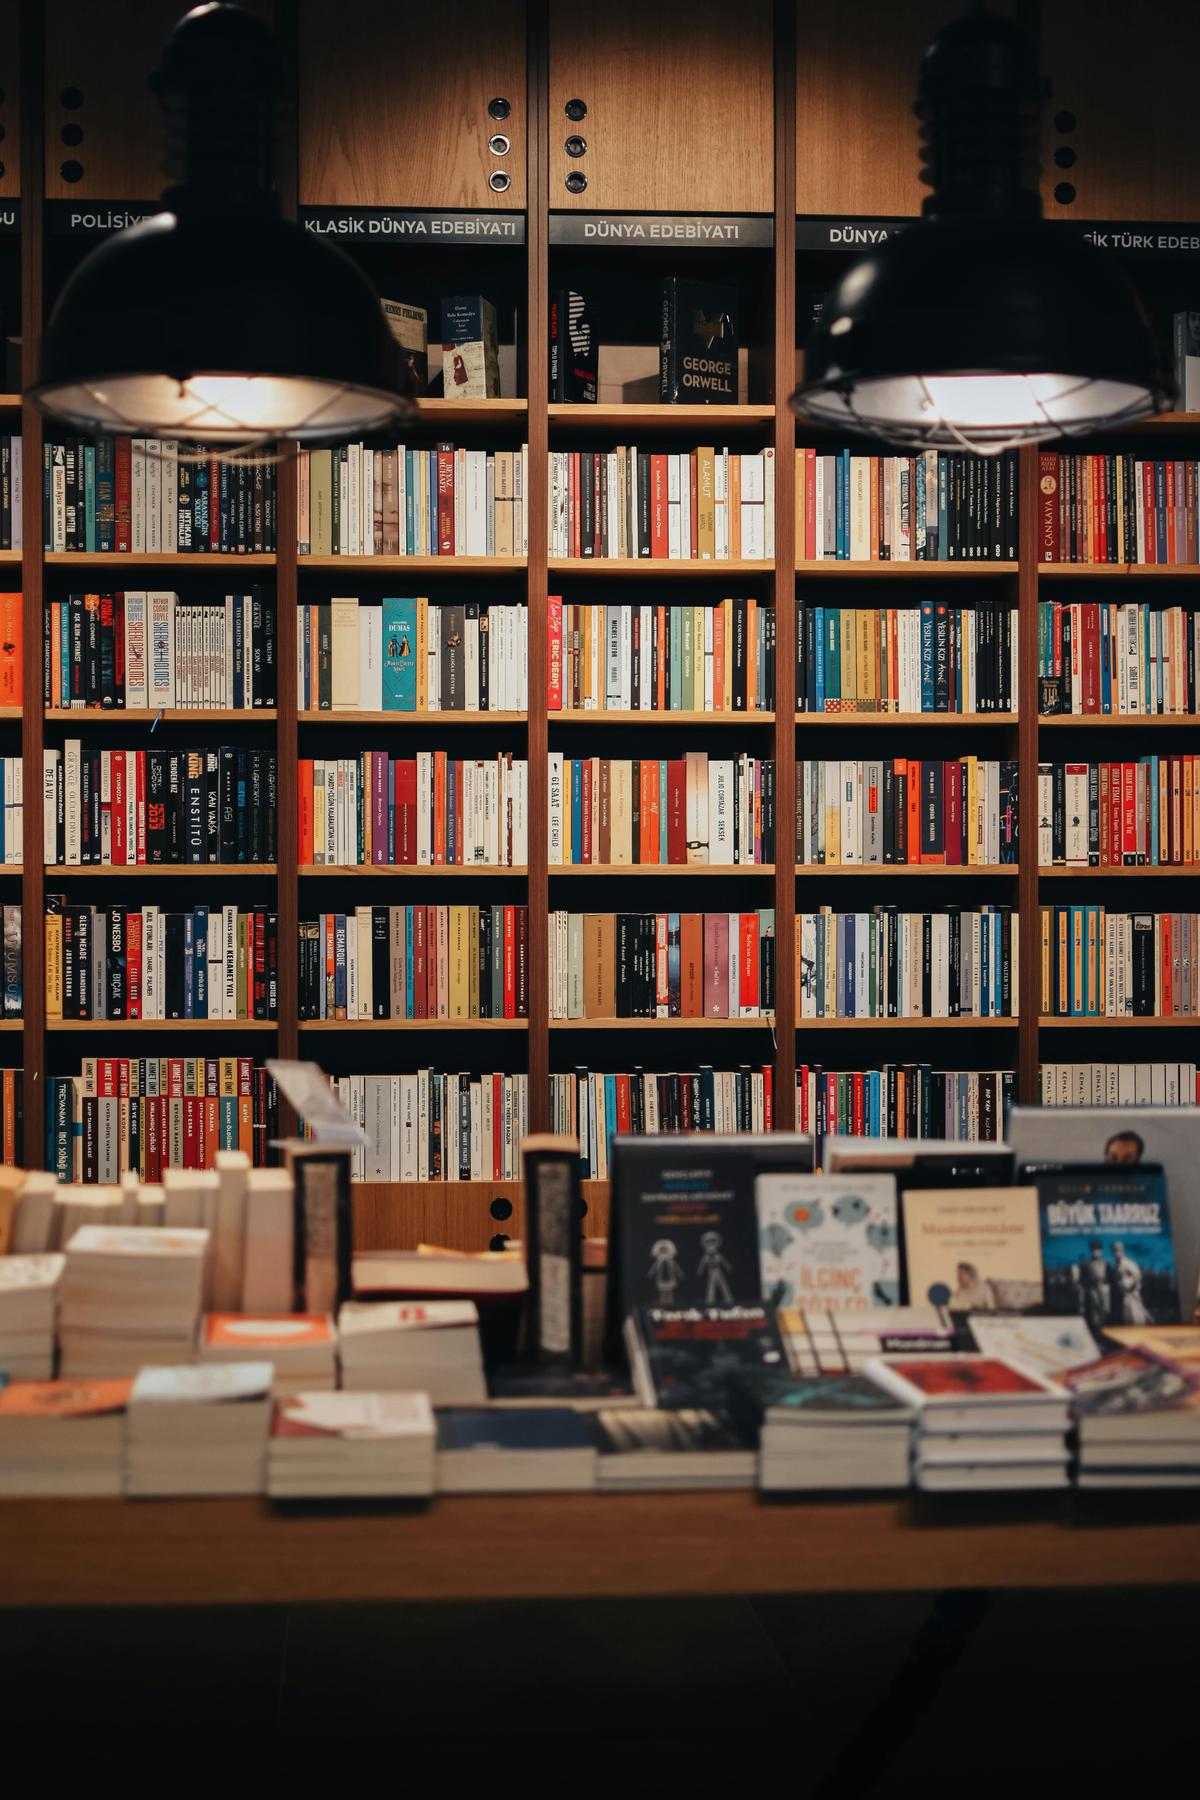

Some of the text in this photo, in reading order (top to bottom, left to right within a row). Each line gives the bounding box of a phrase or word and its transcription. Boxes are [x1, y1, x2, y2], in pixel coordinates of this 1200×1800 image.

[305, 218, 516, 236] KLASİK DÜNYA EDEBİYATI
[584, 221, 739, 239] DÜNYA EDEBİYATI
[829, 226, 888, 244] DÜNYA
[1112, 231, 1143, 249] TÜRK
[682, 356, 732, 376] GEORGE
[682, 374, 732, 392] ORWELL
[1044, 500, 1053, 546] ÇANKAYA
[128, 622, 144, 686] SHERLOCK HOLMES
[154, 622, 170, 686] SHERLOCK HOLMES
[924, 649, 933, 661] KIZI
[938, 649, 946, 661] KIZI
[255, 663, 260, 672] AV
[552, 661, 560, 690] BERNT
[188, 752, 199, 780] KING
[207, 754, 215, 772] KING
[45, 769, 53, 799] DEJA VU
[170, 757, 179, 793] TRENDEKİ KIZ
[552, 777, 558, 786] 61
[148, 803, 158, 830] 2033
[190, 788, 201, 846] ENSTİTÜ
[208, 791, 217, 834] KAN VARSA
[112, 911, 121, 952] JO NESBO
[336, 929, 345, 966] REMARQUE
[7, 932, 17, 1004] UYUMSUZ
[111, 973, 121, 999] BIÇAK
[104, 1063, 112, 1081] AHMET
[120, 1064, 128, 1082] AHMET
[148, 1062, 156, 1080] AHMET
[172, 1064, 181, 1082] AHMET
[186, 1062, 194, 1080] AHMET
[208, 1064, 216, 1082] AHMET
[225, 1063, 233, 1079] AHMET
[241, 1063, 249, 1081] AHMET
[104, 1082, 113, 1095] ÜMİT
[120, 1083, 128, 1096] ÜMİT
[149, 1082, 158, 1094] ÜMİT
[172, 1084, 182, 1097] ÜMİT
[187, 1081, 196, 1094] ÜMİT
[208, 1083, 217, 1096] ÜMİT
[225, 1082, 234, 1094] ÜMİT
[241, 1082, 251, 1095] ÜMİT
[149, 1133, 157, 1153] ÇIĞLIĞI
